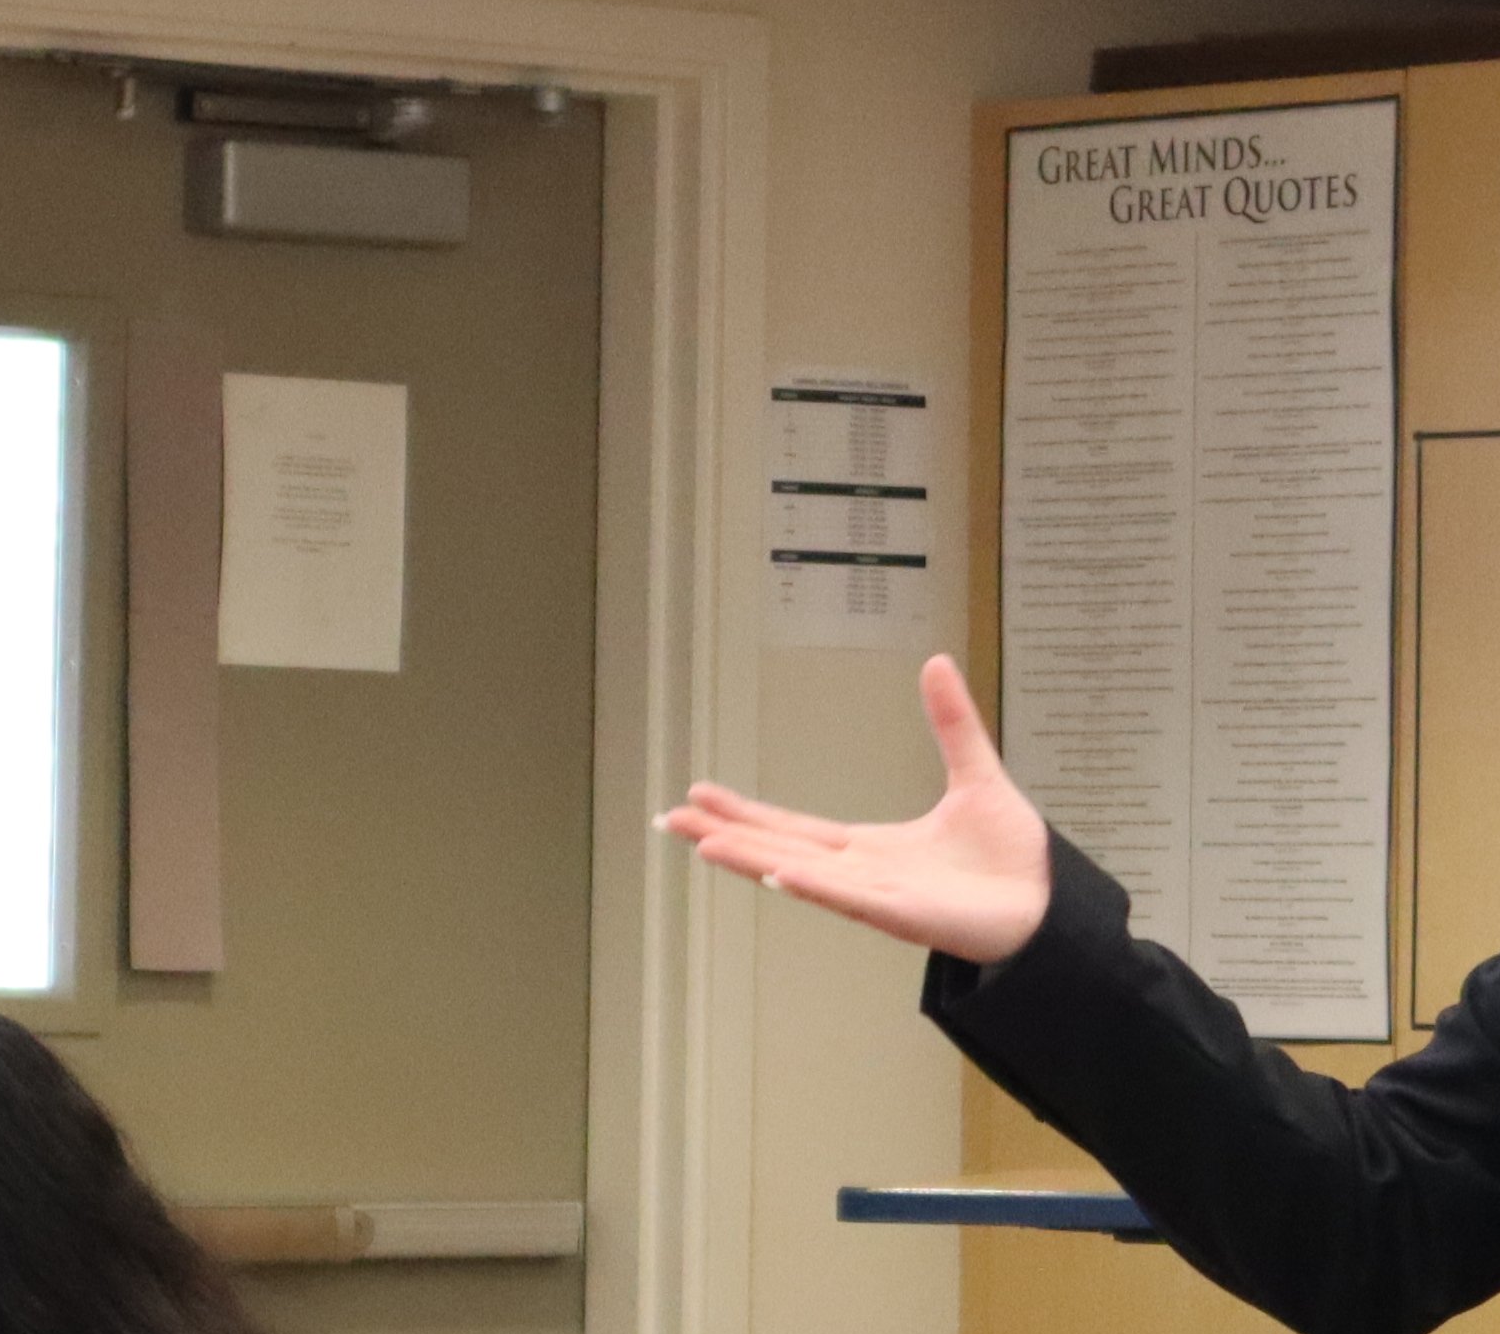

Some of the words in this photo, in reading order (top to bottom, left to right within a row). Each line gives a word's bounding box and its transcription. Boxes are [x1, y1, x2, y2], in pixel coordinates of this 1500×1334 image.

[1037, 145, 1137, 185] GREAT
[1108, 184, 1213, 225] GREAT
[1223, 172, 1358, 224] QUOTES
